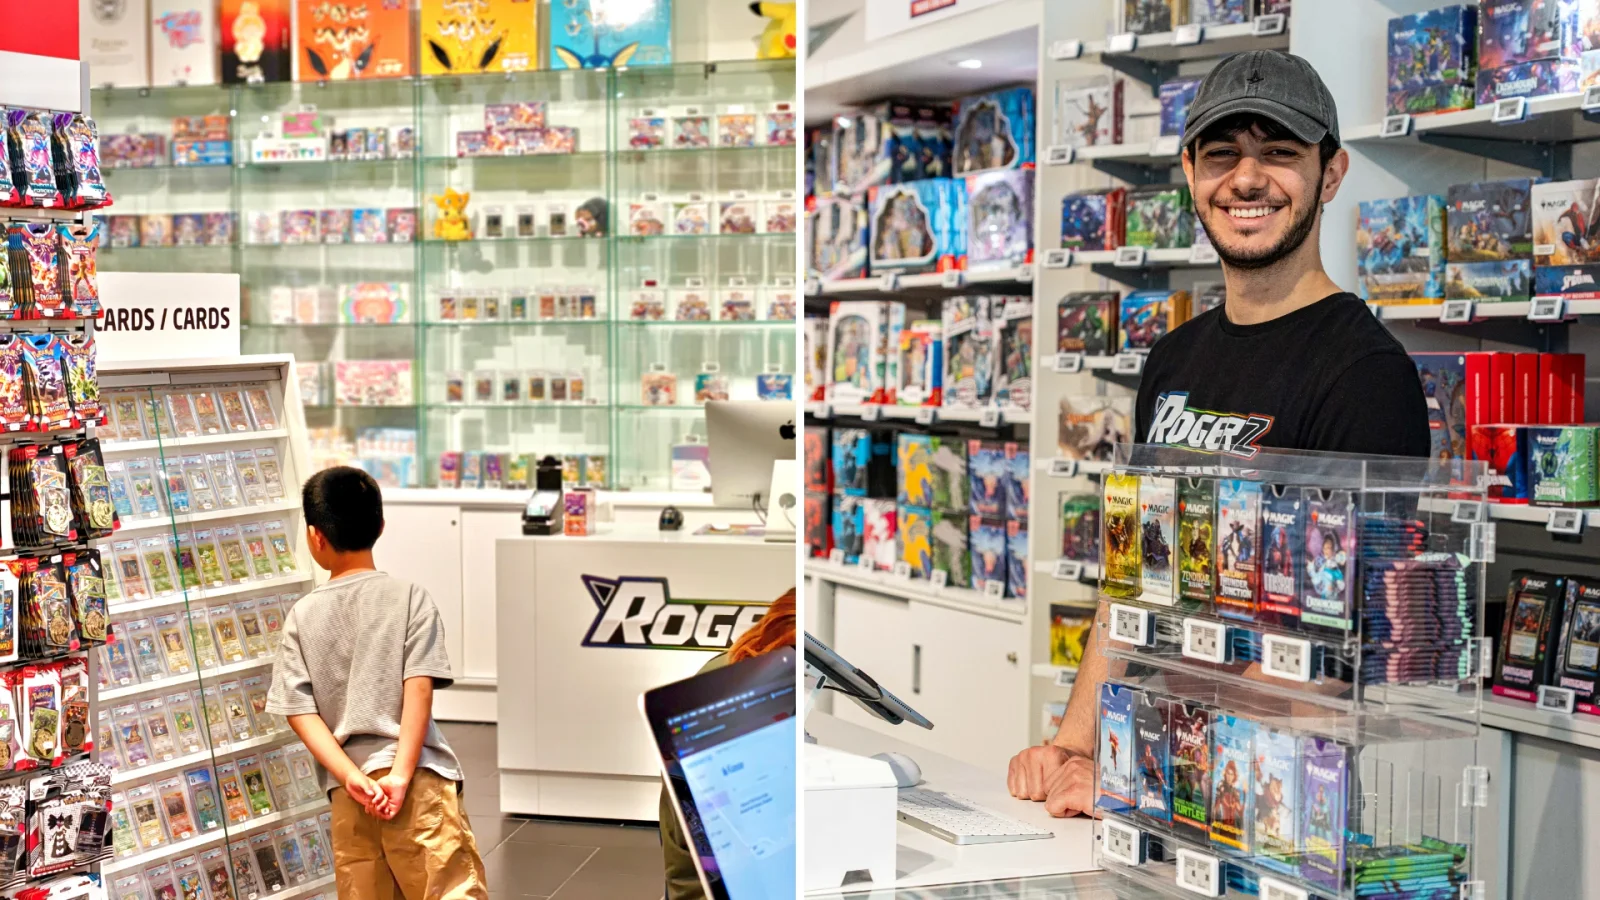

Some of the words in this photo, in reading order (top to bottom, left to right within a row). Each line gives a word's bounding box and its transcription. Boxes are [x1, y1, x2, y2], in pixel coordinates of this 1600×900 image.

[93, 307, 155, 332] CARDS
[160, 307, 168, 331] /
[173, 307, 230, 330] CARDS
[1147, 391, 1271, 458] ROGERZ
[1112, 495, 1133, 506] MAGIC
[1147, 503, 1170, 515] MAGIC
[1185, 503, 1209, 515] MAGIC
[1269, 511, 1296, 525] MAGIC
[1317, 513, 1346, 526] MAGIC
[1525, 579, 1548, 589] MAGIC
[1220, 584, 1253, 599] JUNCTION
[1106, 711, 1128, 724] MAGIC
[1143, 731, 1161, 741] MAGIC
[1181, 731, 1207, 745] MAGIC
[1313, 764, 1340, 783] MAGIC
[1173, 802, 1207, 822] TURTLES
